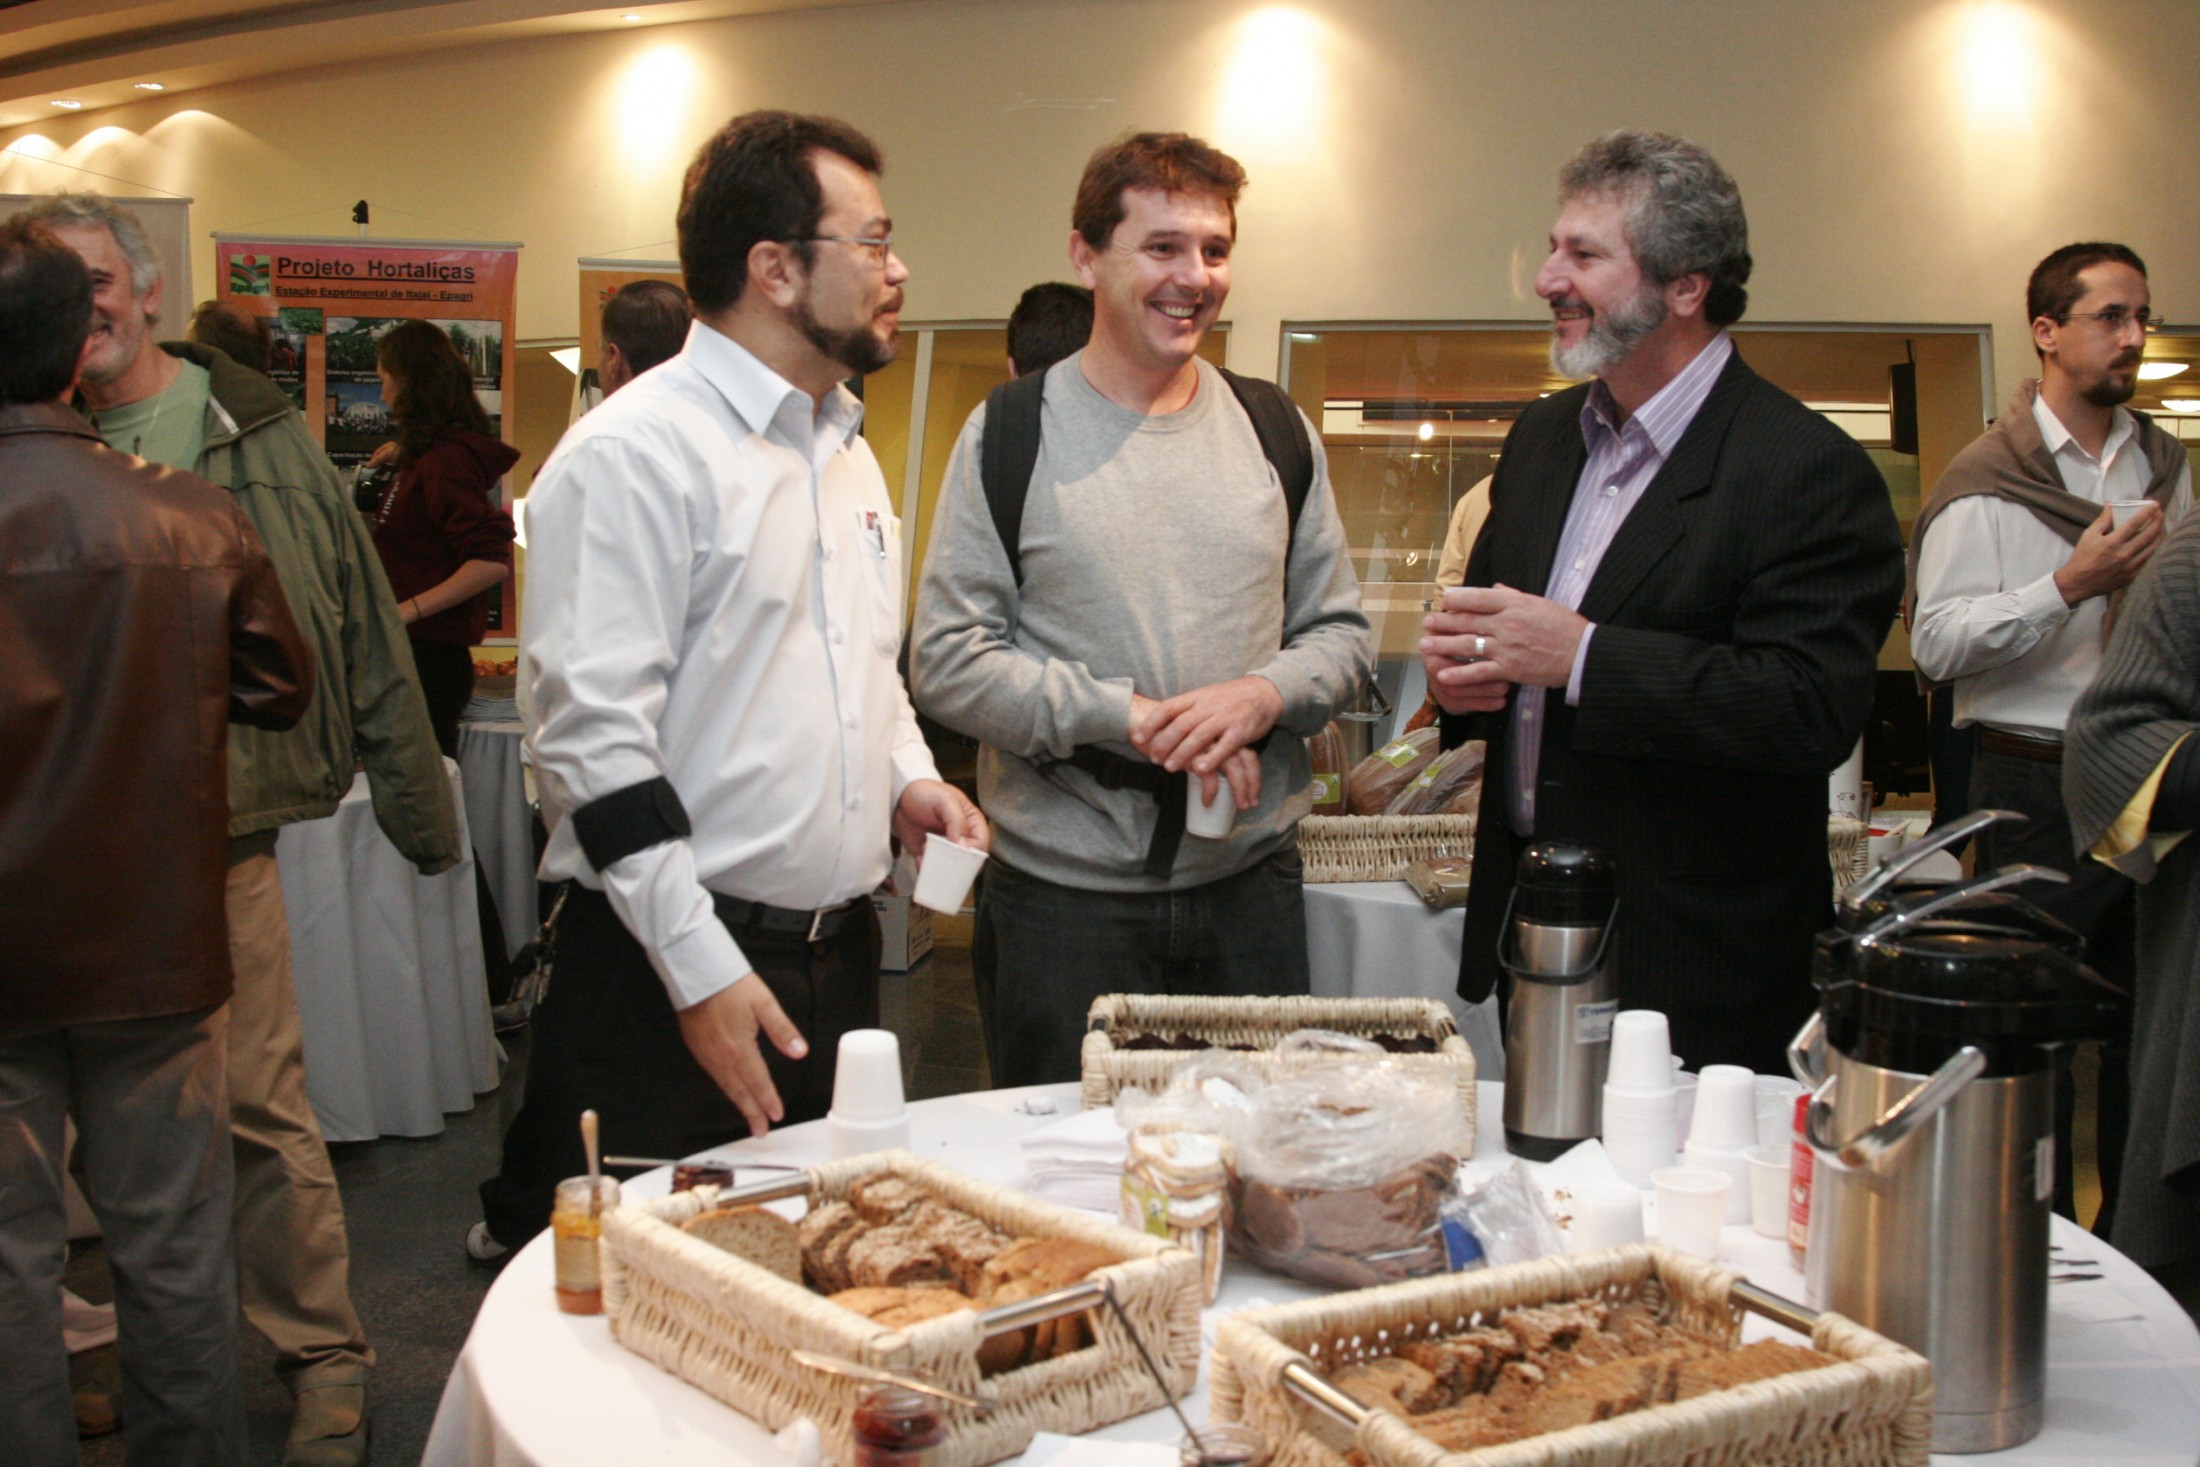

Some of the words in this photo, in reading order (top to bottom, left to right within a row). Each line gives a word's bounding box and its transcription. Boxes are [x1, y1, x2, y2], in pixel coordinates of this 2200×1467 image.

[278, 257, 354, 279] Projeto
[368, 260, 475, 281] Hortaliças
[230, 282, 270, 295] Epagri
[276, 286, 317, 297] Estação
[321, 287, 387, 298] Experimental
[391, 289, 404, 298] de
[440, 291, 473, 301] Epagri
